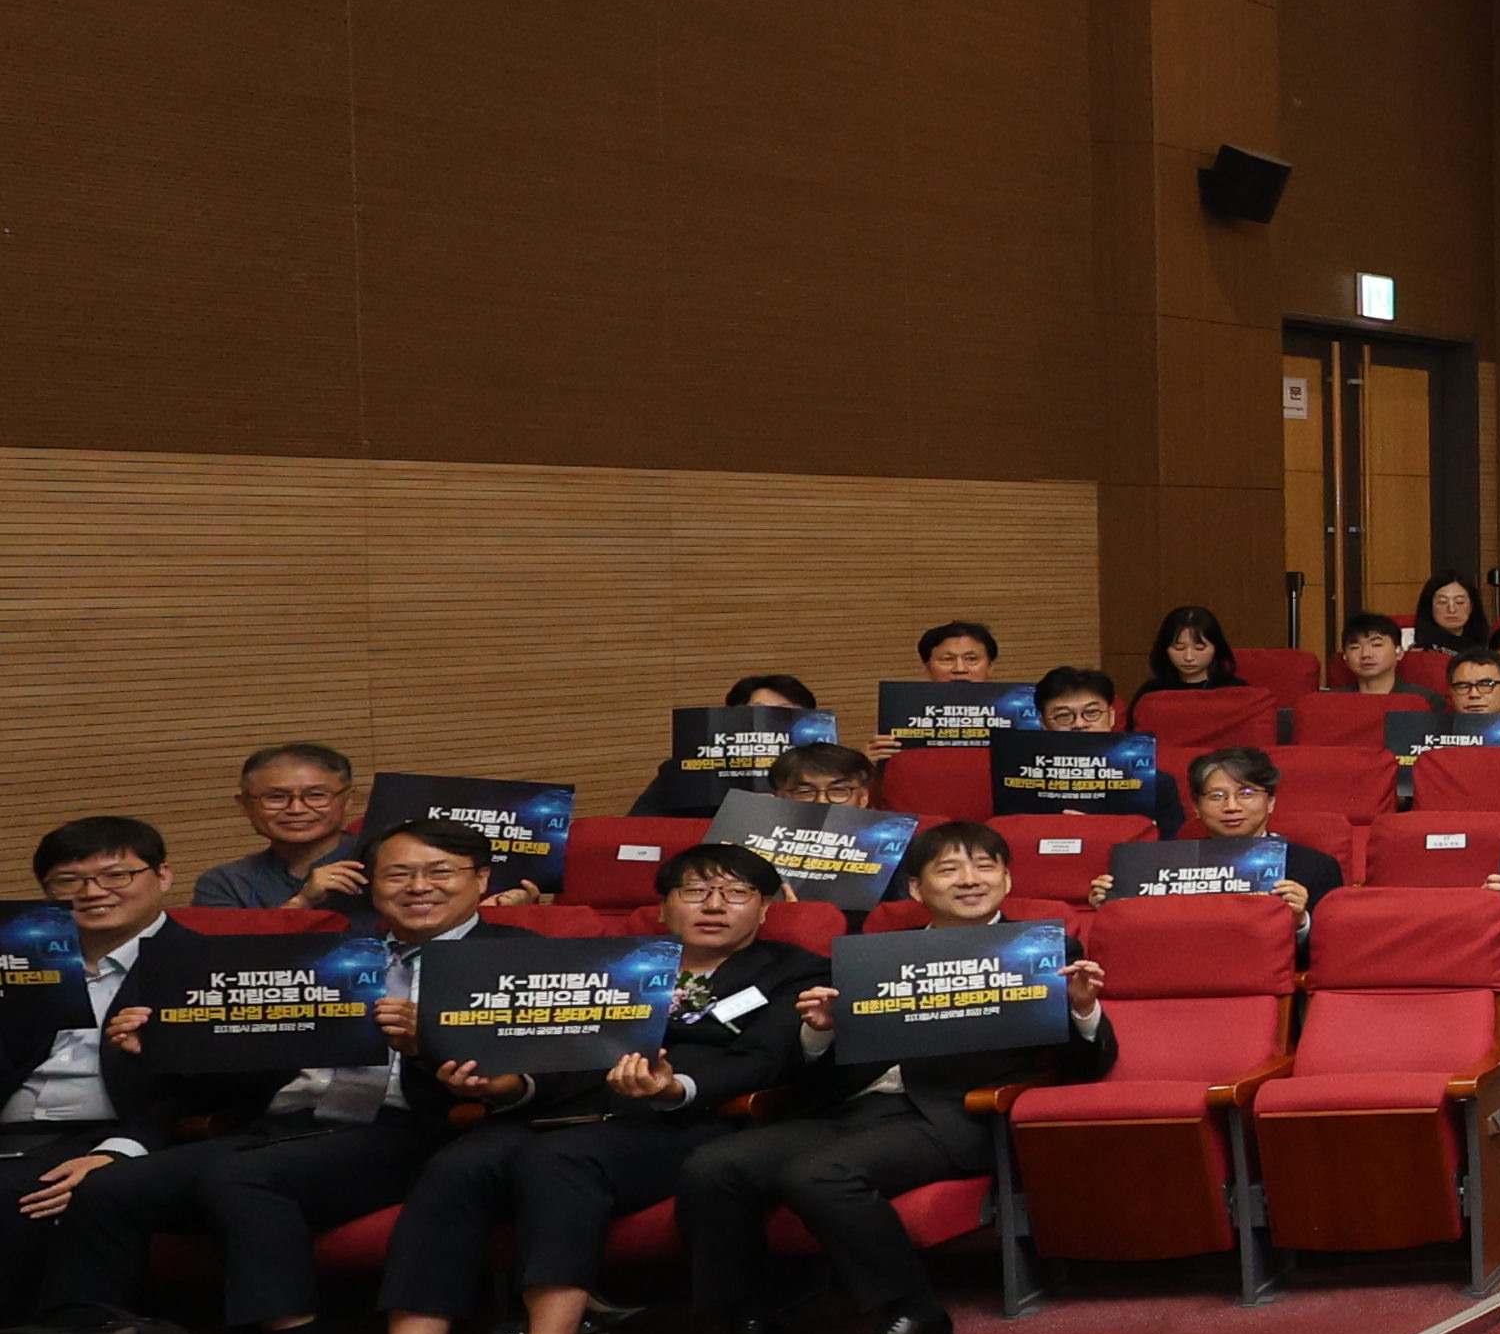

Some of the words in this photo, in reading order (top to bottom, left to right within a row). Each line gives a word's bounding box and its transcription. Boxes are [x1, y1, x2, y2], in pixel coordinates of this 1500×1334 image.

[211, 970, 315, 987] K-피지컬AI
[187, 990, 223, 1005] 기술
[228, 988, 299, 1004] 자립으로
[305, 987, 340, 1002] 여는
[230, 1005, 262, 1020] 산업
